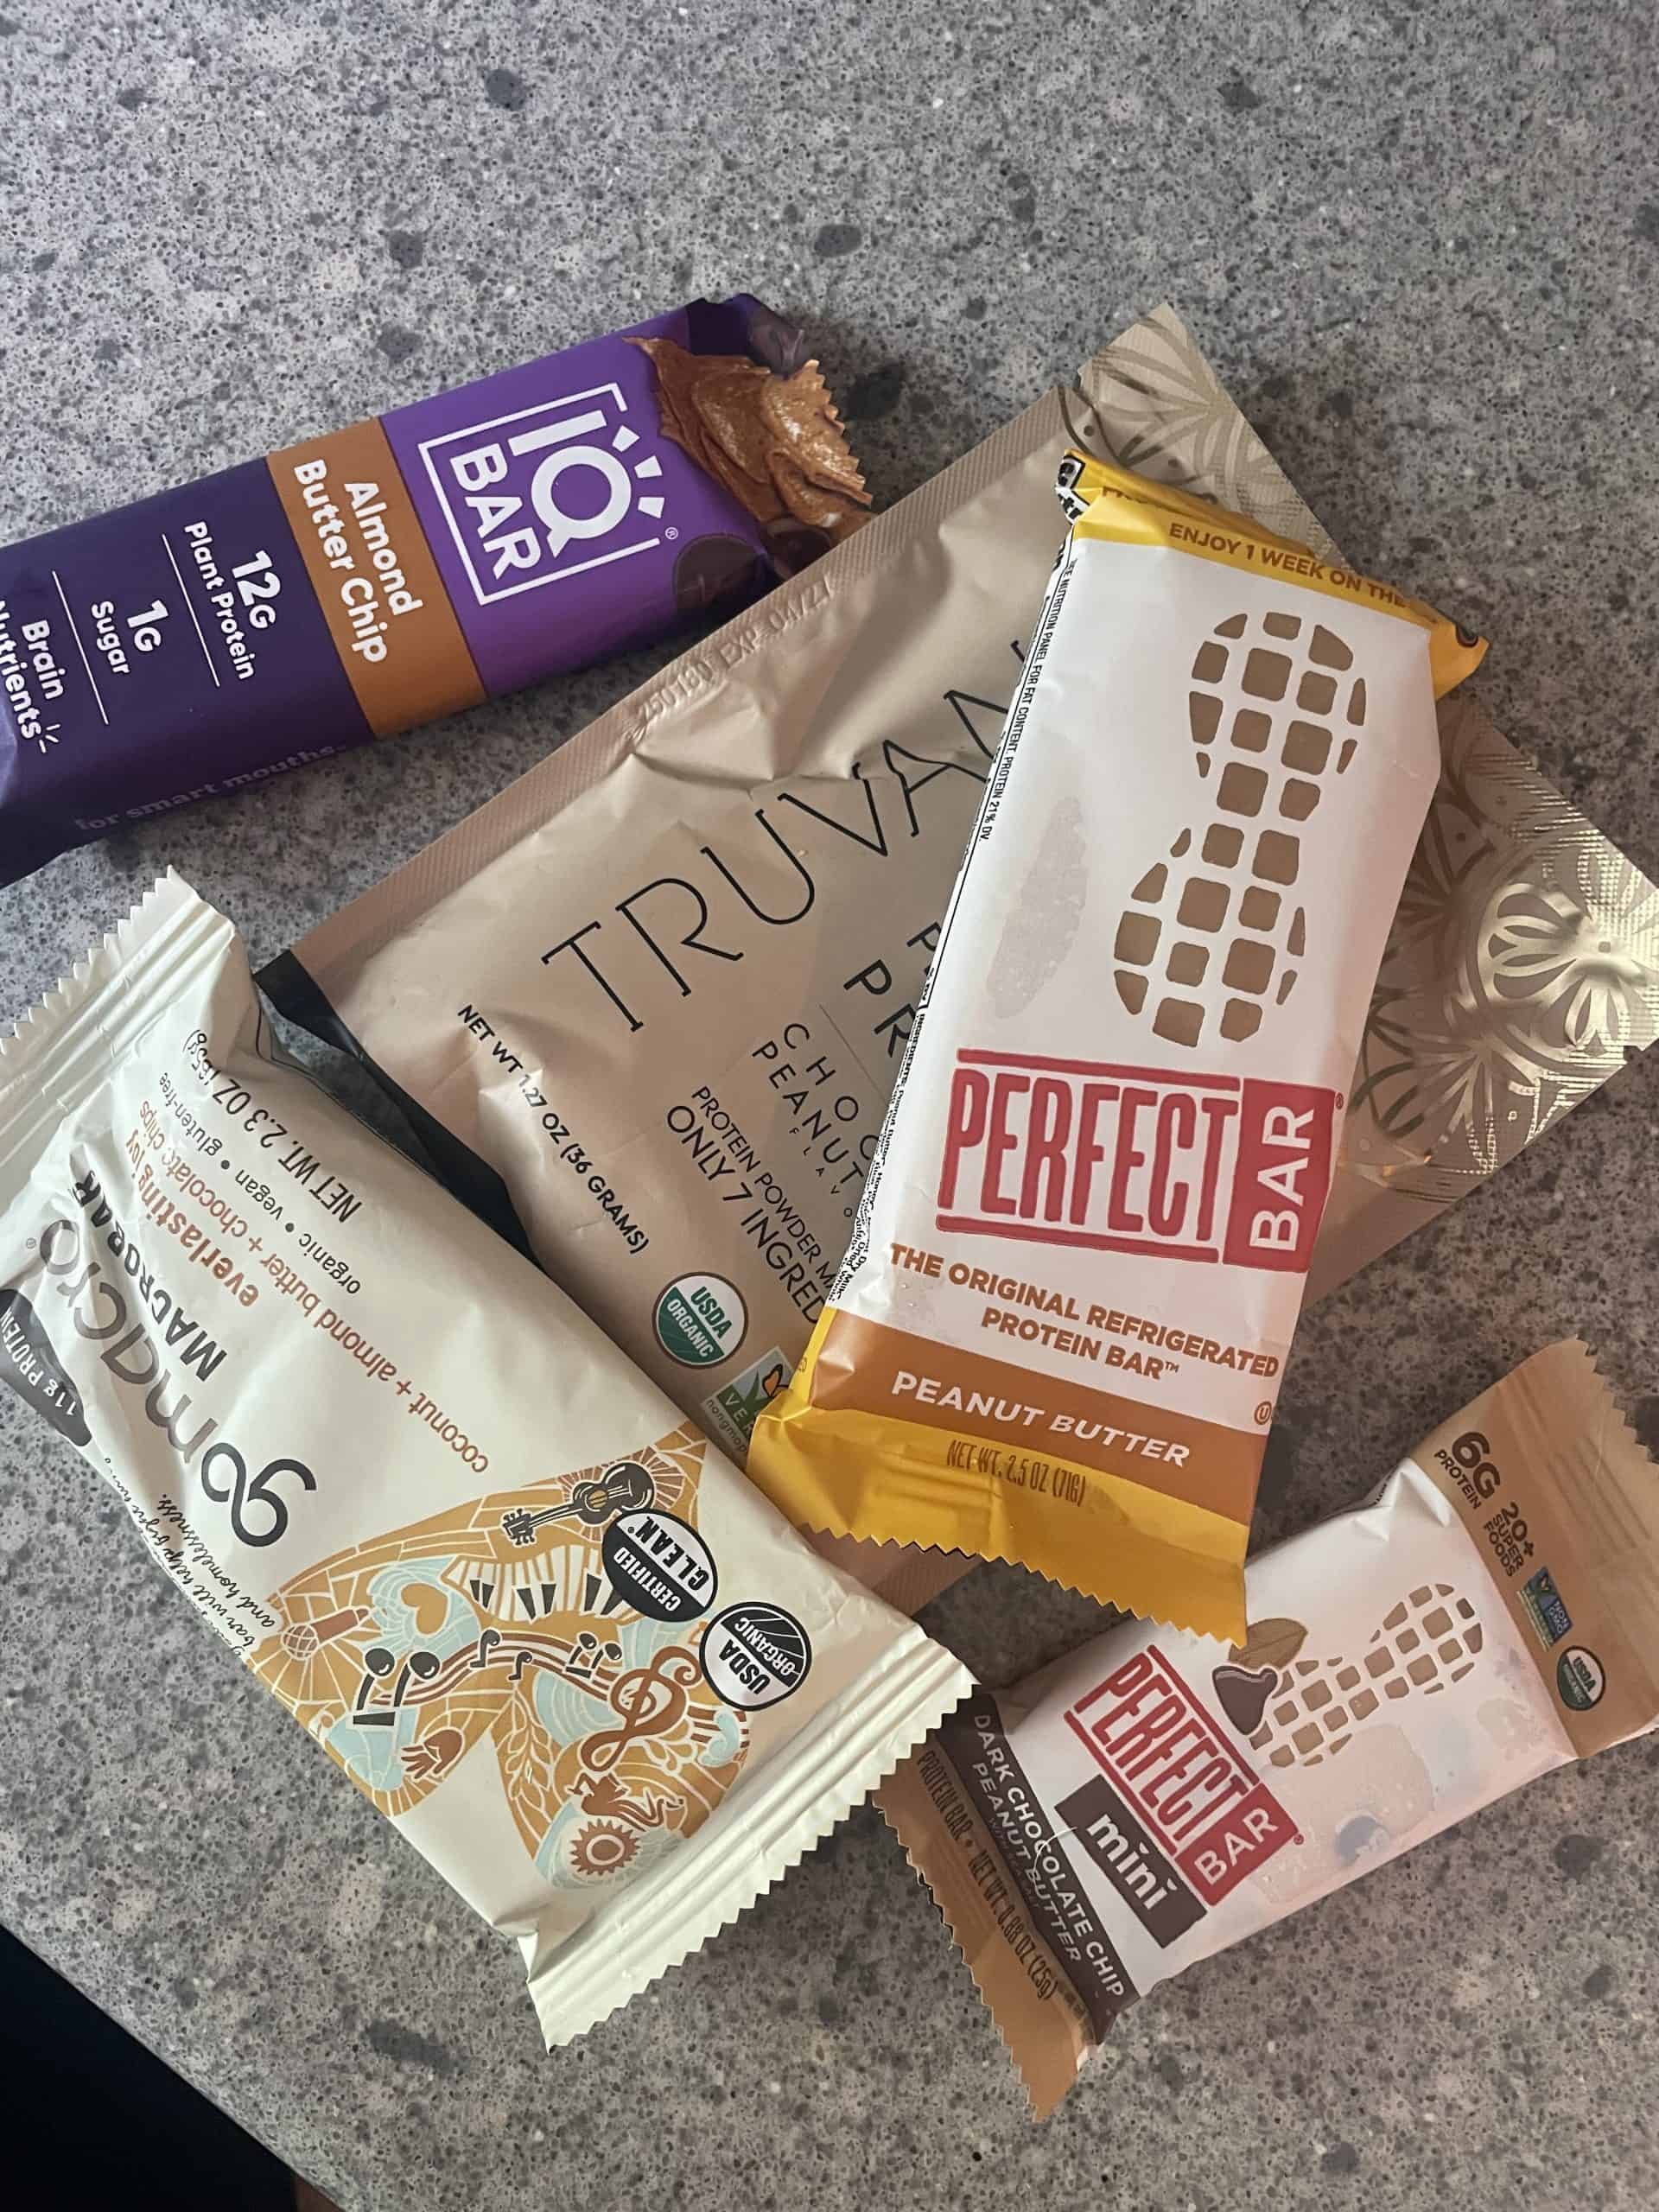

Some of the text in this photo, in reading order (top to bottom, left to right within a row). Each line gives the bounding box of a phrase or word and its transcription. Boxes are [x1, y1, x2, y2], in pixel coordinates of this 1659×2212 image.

[450, 442, 542, 580] BAR
[294, 459, 388, 663] Butter Chip
[344, 481, 423, 616] Almond
[1169, 522, 1242, 557] ENJOY
[1245, 544, 1256, 562] 1
[1259, 546, 1326, 581] WEEK
[1329, 568, 1363, 593] ON
[184, 520, 257, 680] Plant Protein
[232, 550, 281, 629] 12G
[1045, 576, 1070, 631] NUTRITION
[21, 620, 66, 700] Brain
[91, 601, 130, 674] Sugar
[127, 600, 169, 652] 1G
[1036, 629, 1053, 661] PANEL
[1022, 683, 1036, 704] FAT
[1027, 664, 1042, 684] FOR
[125, 783, 217, 819] smart
[993, 755, 1014, 799] PROTEIN
[984, 800, 1000, 823] 21%
[139, 1100, 166, 1151] chips
[213, 1078, 251, 1115] OZ
[243, 1109, 285, 1149] 2.3
[457, 1004, 649, 1254] NET WT 1.27 OZ (36 GRAMS)
[752, 1040, 864, 1185] PEANUT
[159, 1072, 361, 1295] organic vegan gluten-free
[277, 1138, 322, 1190] WT.
[666, 1104, 735, 1182] ONLY
[722, 1181, 753, 1203] 7
[691, 1085, 761, 1174] PROTEIN
[754, 1172, 822, 1264] POWDER
[937, 1067, 1239, 1243] PERFECT
[1249, 1105, 1316, 1251] BAR
[162, 1148, 249, 1241] chocolate
[320, 1176, 363, 1224] NET
[137, 1160, 259, 1307] everlasting
[69, 1169, 227, 1382] MACROBAR
[260, 1251, 321, 1319] butter
[315, 1307, 398, 1382] almond
[666, 1298, 715, 1358] ORGANIC
[690, 1286, 733, 1338] USDA
[890, 1243, 1280, 1378] THE ORIGINAL REFRIGERATED
[981, 1306, 1103, 1362] PROTEIN
[43, 1377, 76, 1415] 11g
[891, 1370, 1192, 1468] PEANUT BUTTER
[409, 1391, 489, 1474] coconut
[1452, 1431, 1501, 1499] 6G
[946, 1439, 1086, 1508] NET WT. 2.5 OZ (71G)
[1433, 1449, 1482, 1510] PROTEIN
[157, 1493, 240, 1599] homelessness.
[634, 1516, 709, 1592] CLEAN
[1483, 1521, 1517, 1578] FOODS
[1492, 1513, 1525, 1570] SUPER
[1500, 1502, 1534, 1558] 20+
[162, 1547, 194, 1585] help
[613, 1547, 682, 1611] CERTIFIED
[193, 1585, 228, 1618] will
[236, 1596, 276, 1628] and
[718, 1638, 772, 1695] USDA
[734, 1617, 796, 1676] ORGANIC
[1573, 1656, 1597, 1693] USDA
[1074, 1652, 1280, 1886] PERFECT BAR
[917, 1750, 954, 1812] PROTEIN
[943, 1802, 974, 1840] BAR
[968, 1851, 994, 1889] NET
[1014, 1931, 1038, 1965] OZ
[1028, 1954, 1059, 2000] (25g)
[972, 1763, 1032, 1861] PEANUT
[1024, 1866, 1082, 1962] BUTTER
[974, 1714, 1125, 1997] DARK CHOCOLATE CHIP
[1085, 1814, 1179, 1910] mini
